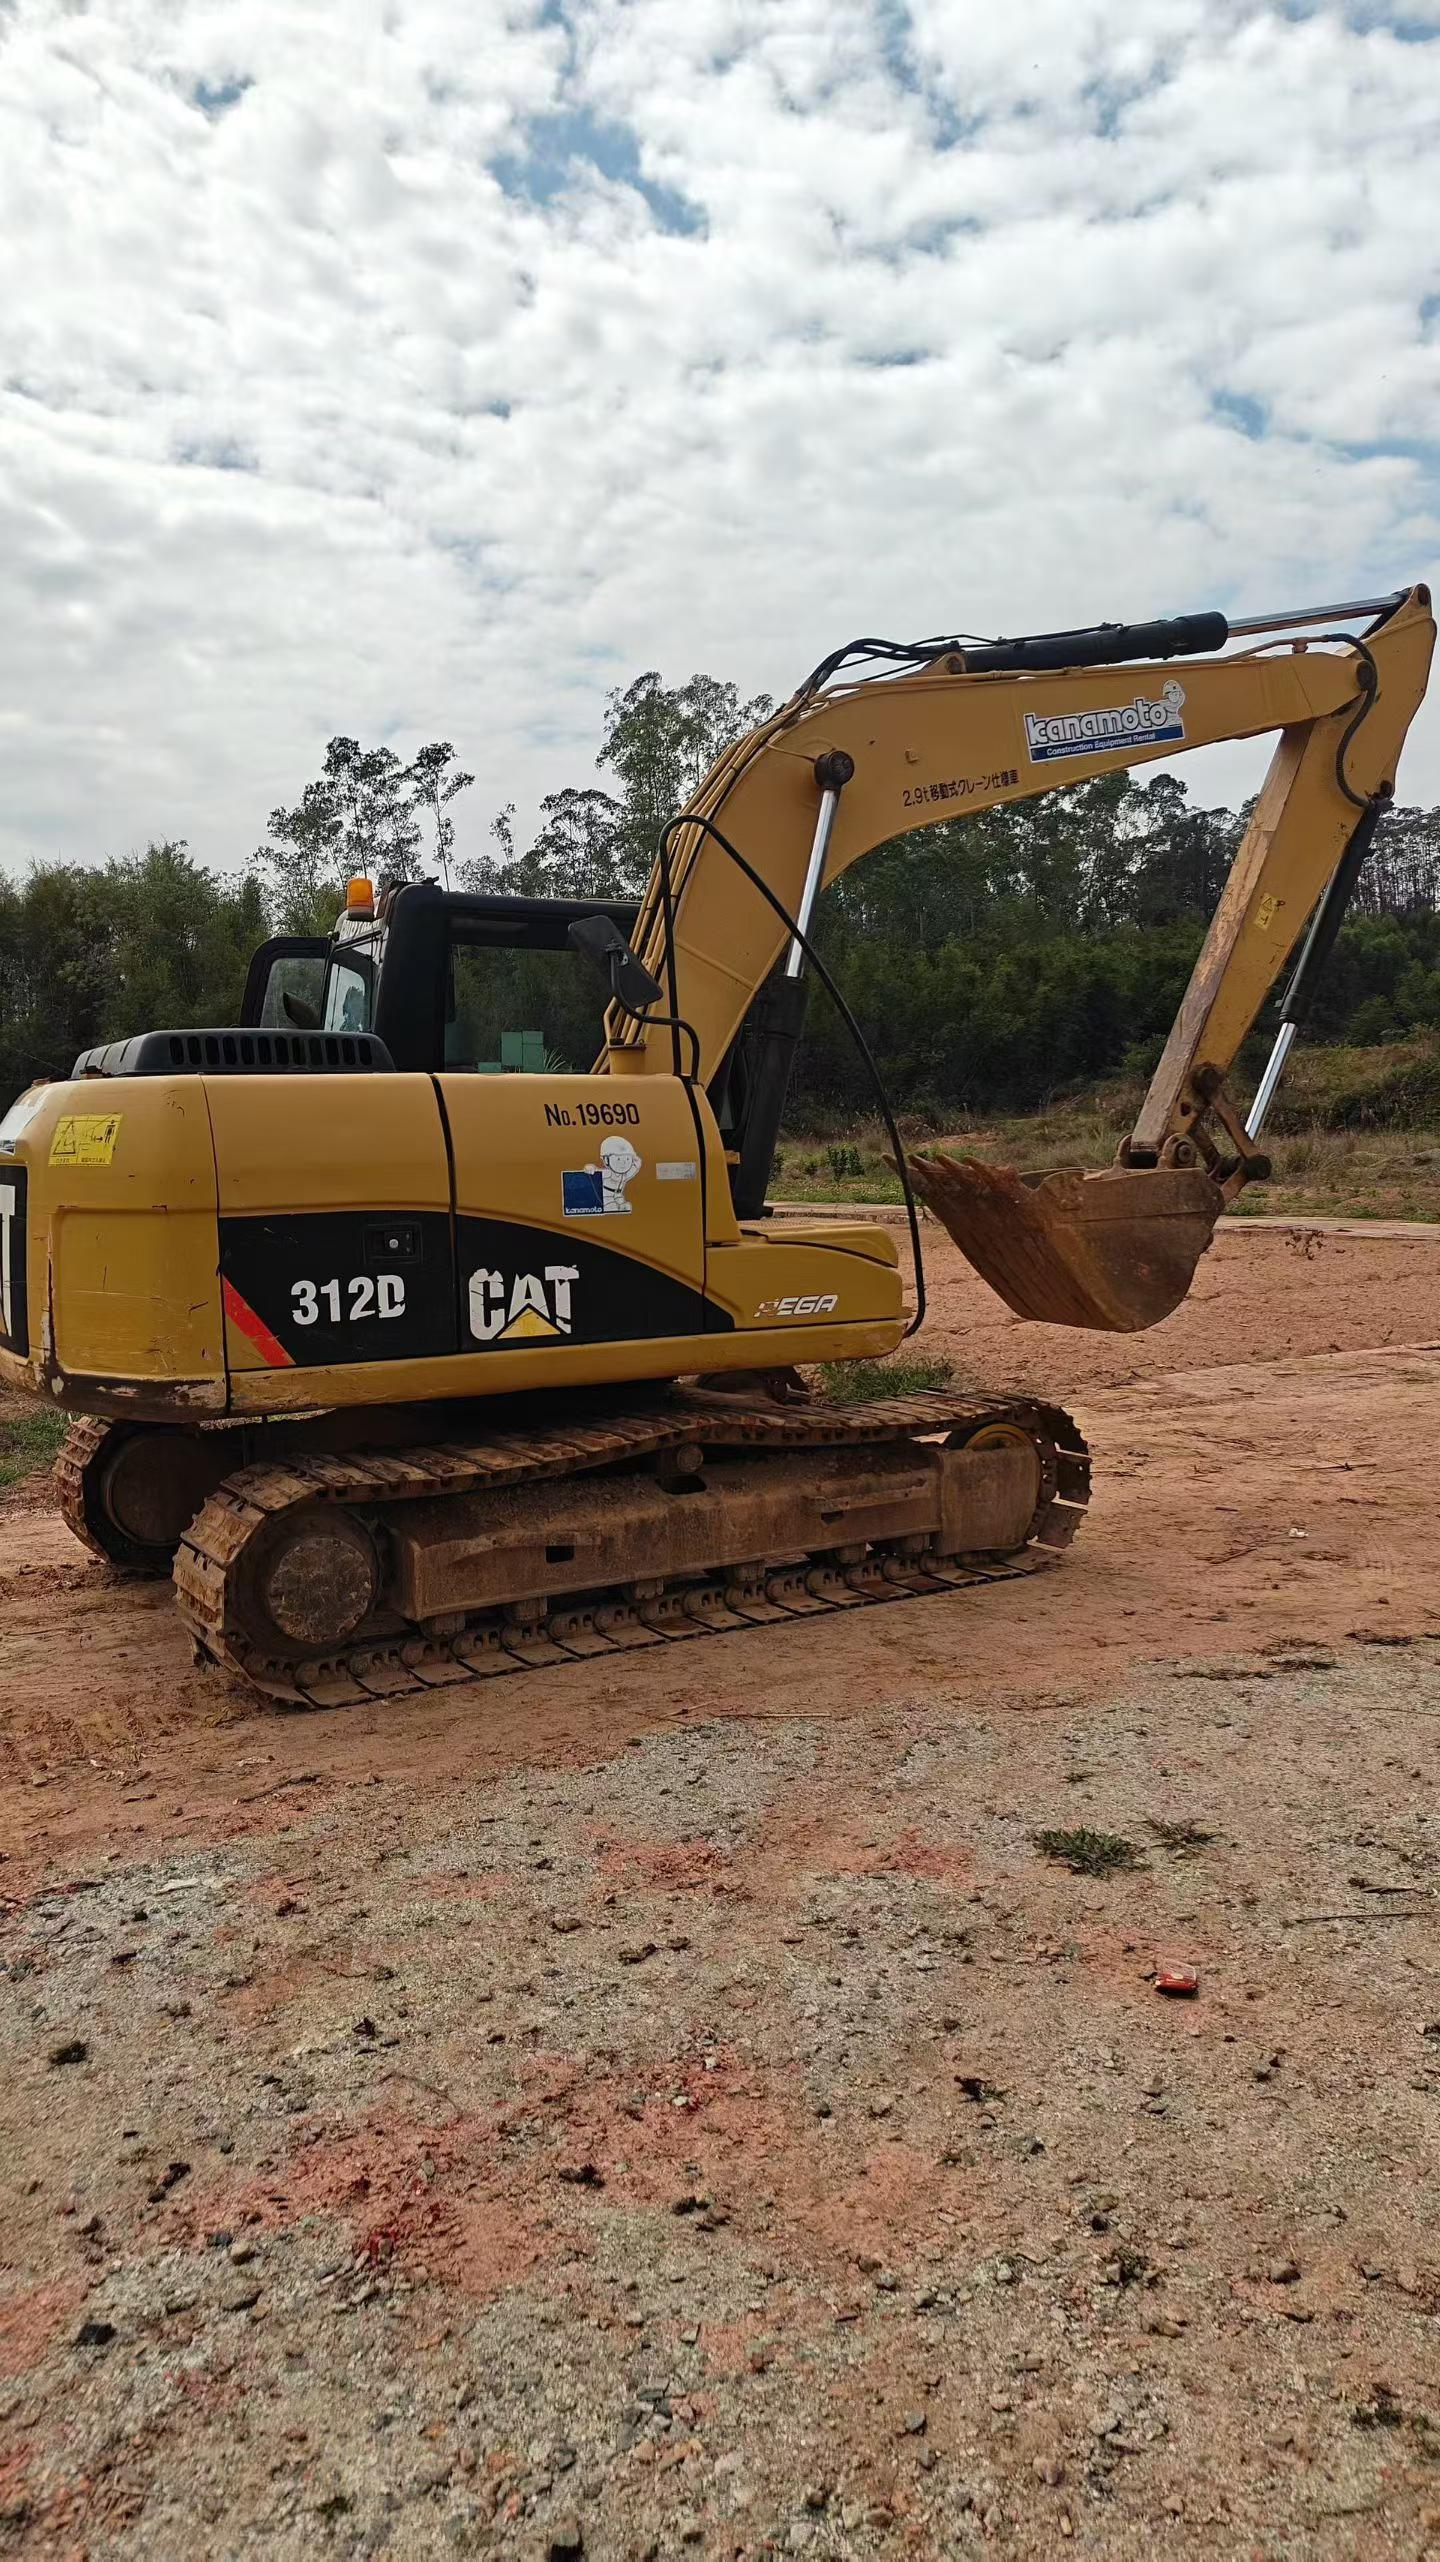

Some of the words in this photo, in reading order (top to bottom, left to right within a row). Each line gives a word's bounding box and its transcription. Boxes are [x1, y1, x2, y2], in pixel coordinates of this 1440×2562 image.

[1025, 699, 1167, 746] kanamoto
[1046, 743, 1093, 757] Construction
[1094, 736, 1133, 750] Equipment
[1133, 732, 1156, 744] Rental
[543, 1103, 640, 1127] No.19690
[290, 1274, 406, 1326] 312D
[468, 1264, 580, 1341] CAT
